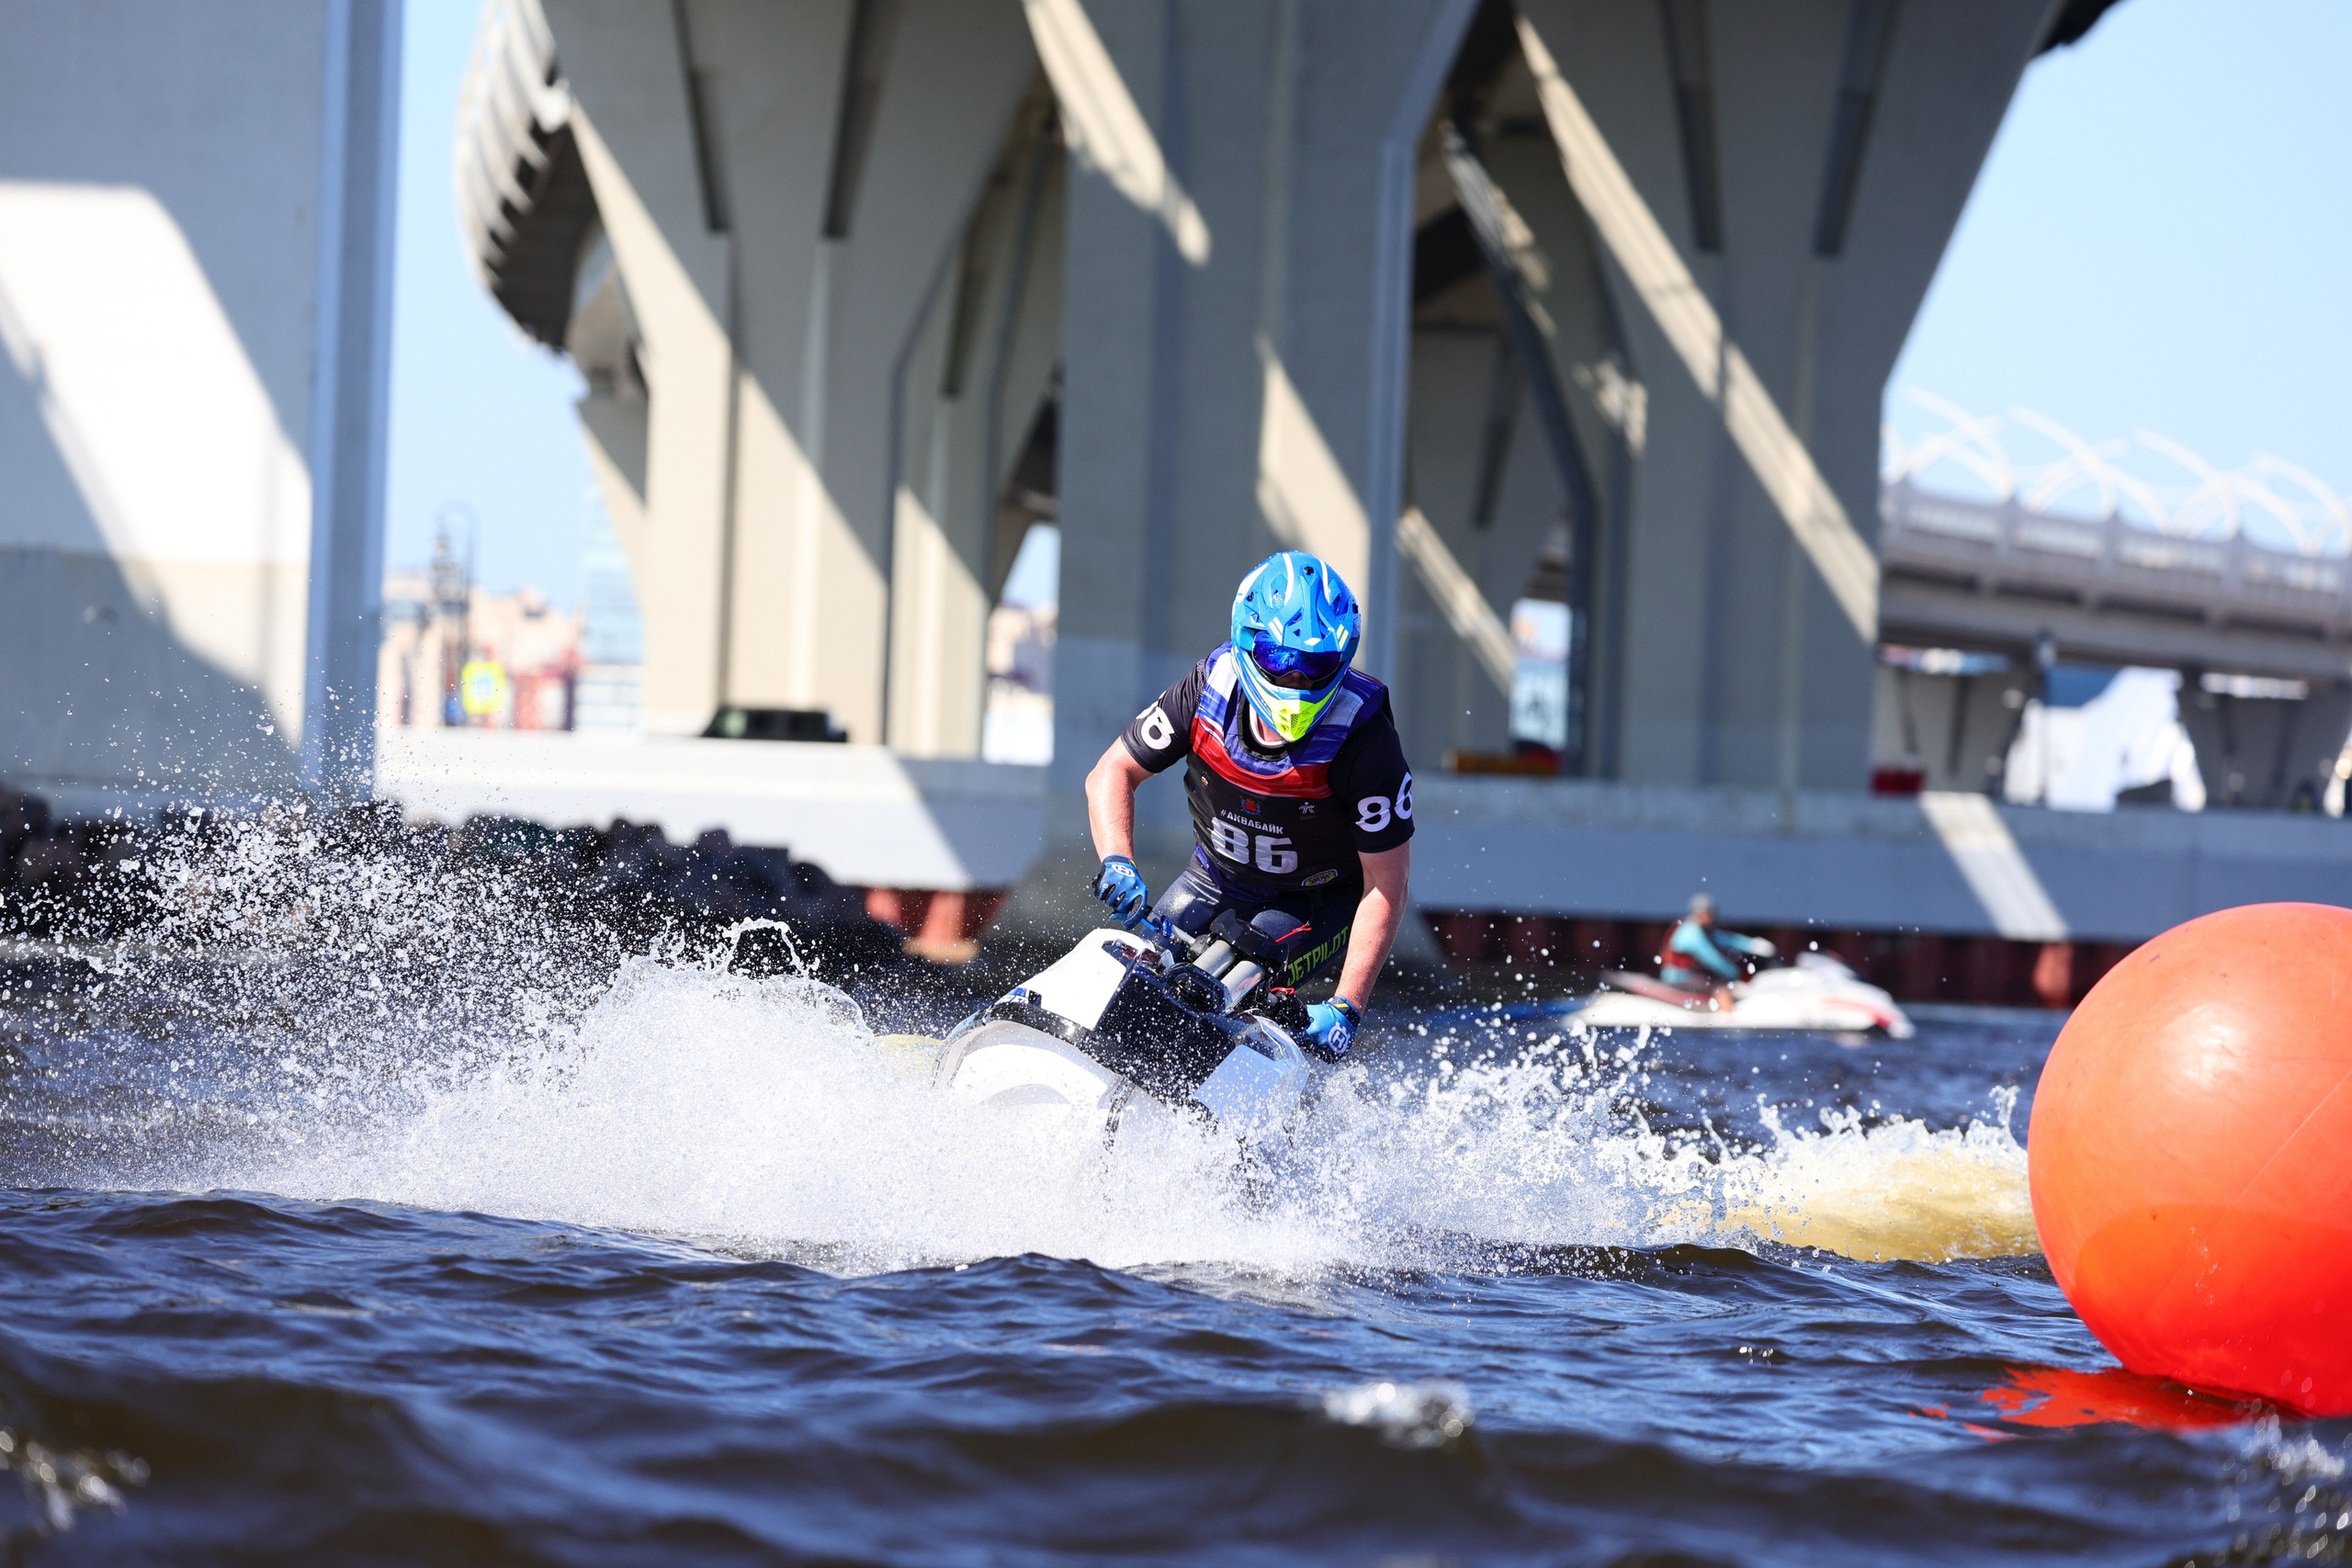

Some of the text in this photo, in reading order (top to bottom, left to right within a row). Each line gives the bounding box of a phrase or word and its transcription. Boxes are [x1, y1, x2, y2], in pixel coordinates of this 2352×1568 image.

[1220, 808, 1284, 835] #АКВАБАЙК
[1355, 773, 1413, 832] 86
[1211, 817, 1298, 874] 86
[1287, 926, 1349, 987] JETPILOT
